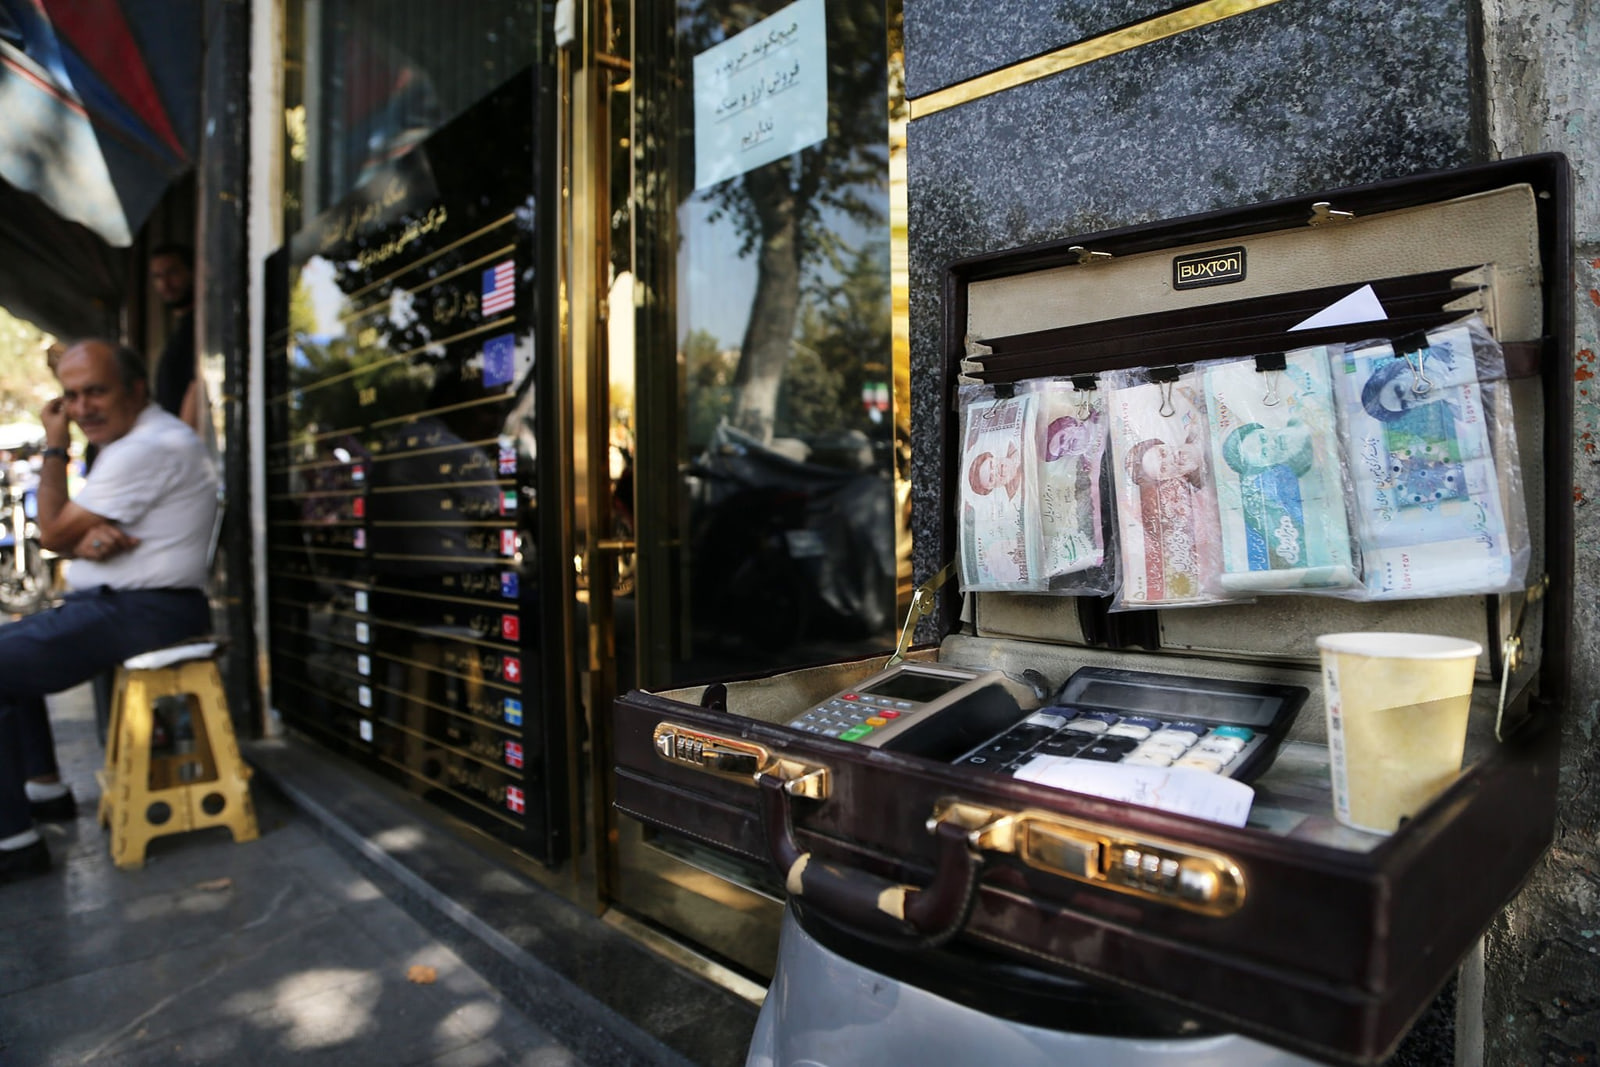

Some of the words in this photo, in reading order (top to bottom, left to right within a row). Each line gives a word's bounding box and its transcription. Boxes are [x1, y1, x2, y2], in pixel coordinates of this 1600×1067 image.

[1181, 258, 1238, 277] BUXTON
[1302, 372, 1316, 397] ۱۰۰۰۰
[1361, 436, 1380, 456] بانک
[1134, 577, 1145, 600] ۵۰۰۰
[1383, 562, 1394, 592] ۲۰۰۰۰
